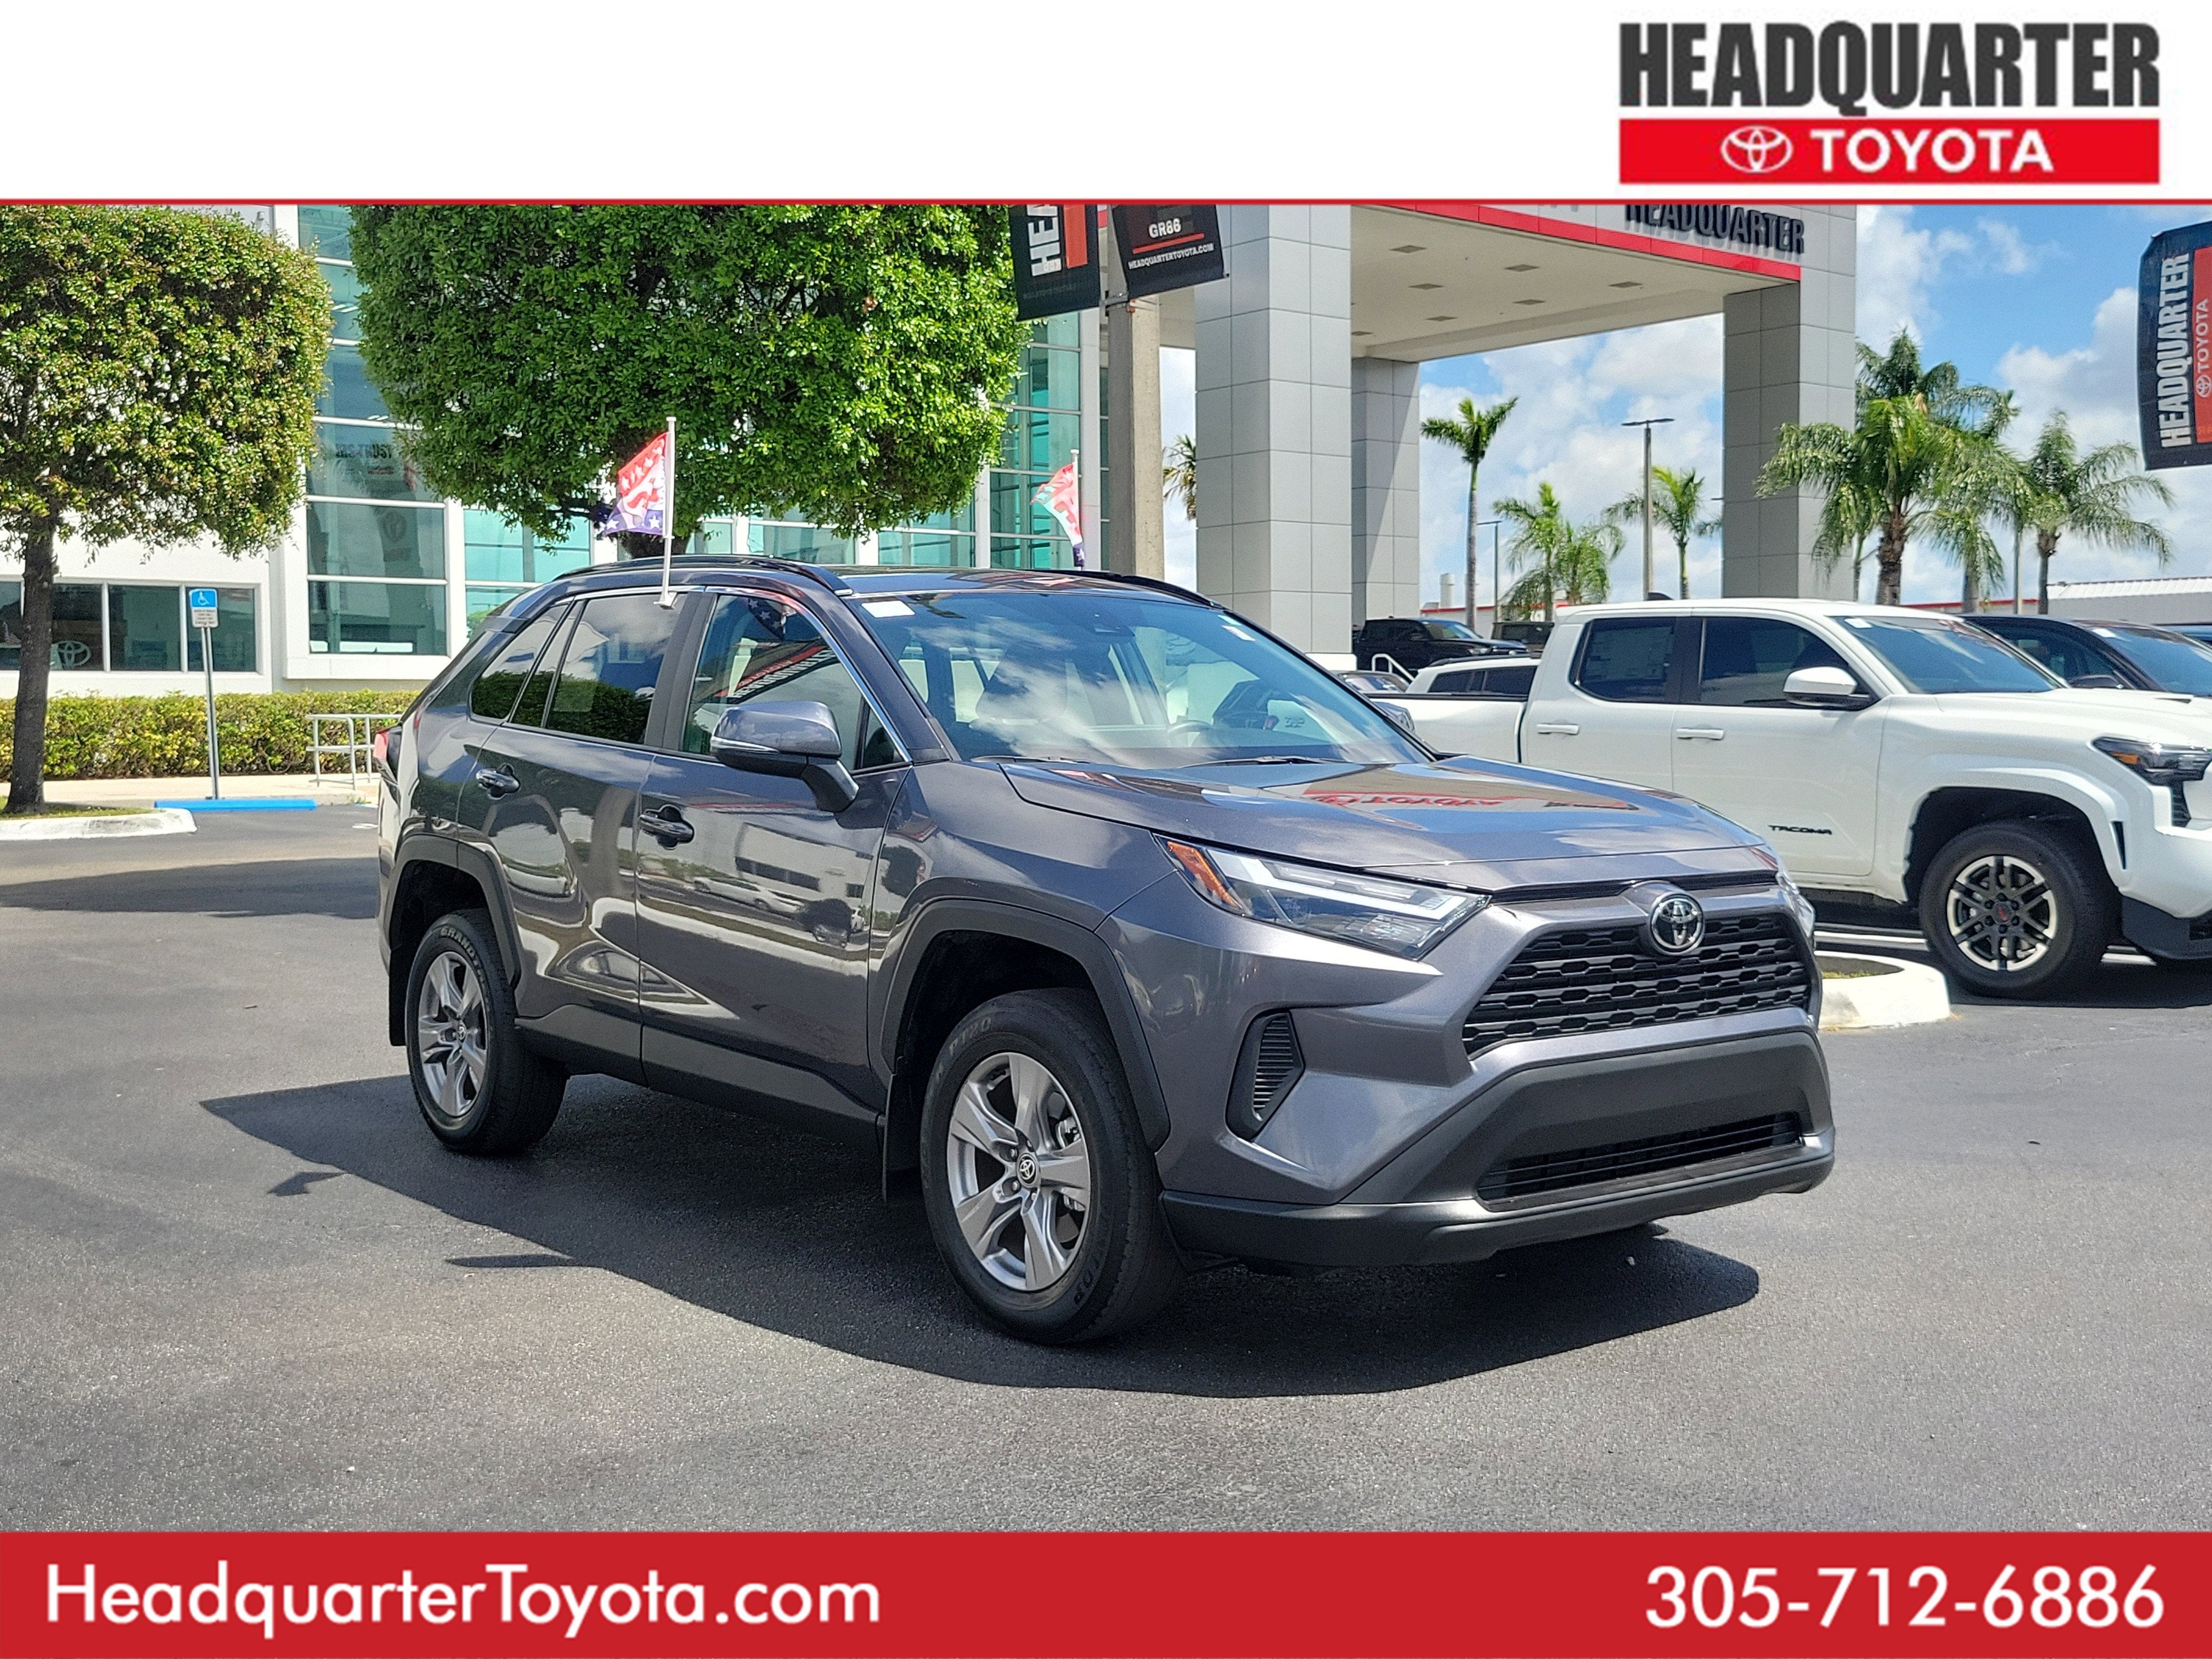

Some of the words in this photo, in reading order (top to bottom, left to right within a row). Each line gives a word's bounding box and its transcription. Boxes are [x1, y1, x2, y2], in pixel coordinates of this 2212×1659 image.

[1149, 218, 1182, 239] GR86
[1128, 242, 1214, 270] HEADQUARTERTOYOTA.COM
[2196, 298, 2209, 373] TOYOTA
[2156, 252, 2193, 448] HEADQUARTER
[1768, 825, 1832, 835] TACOMA
